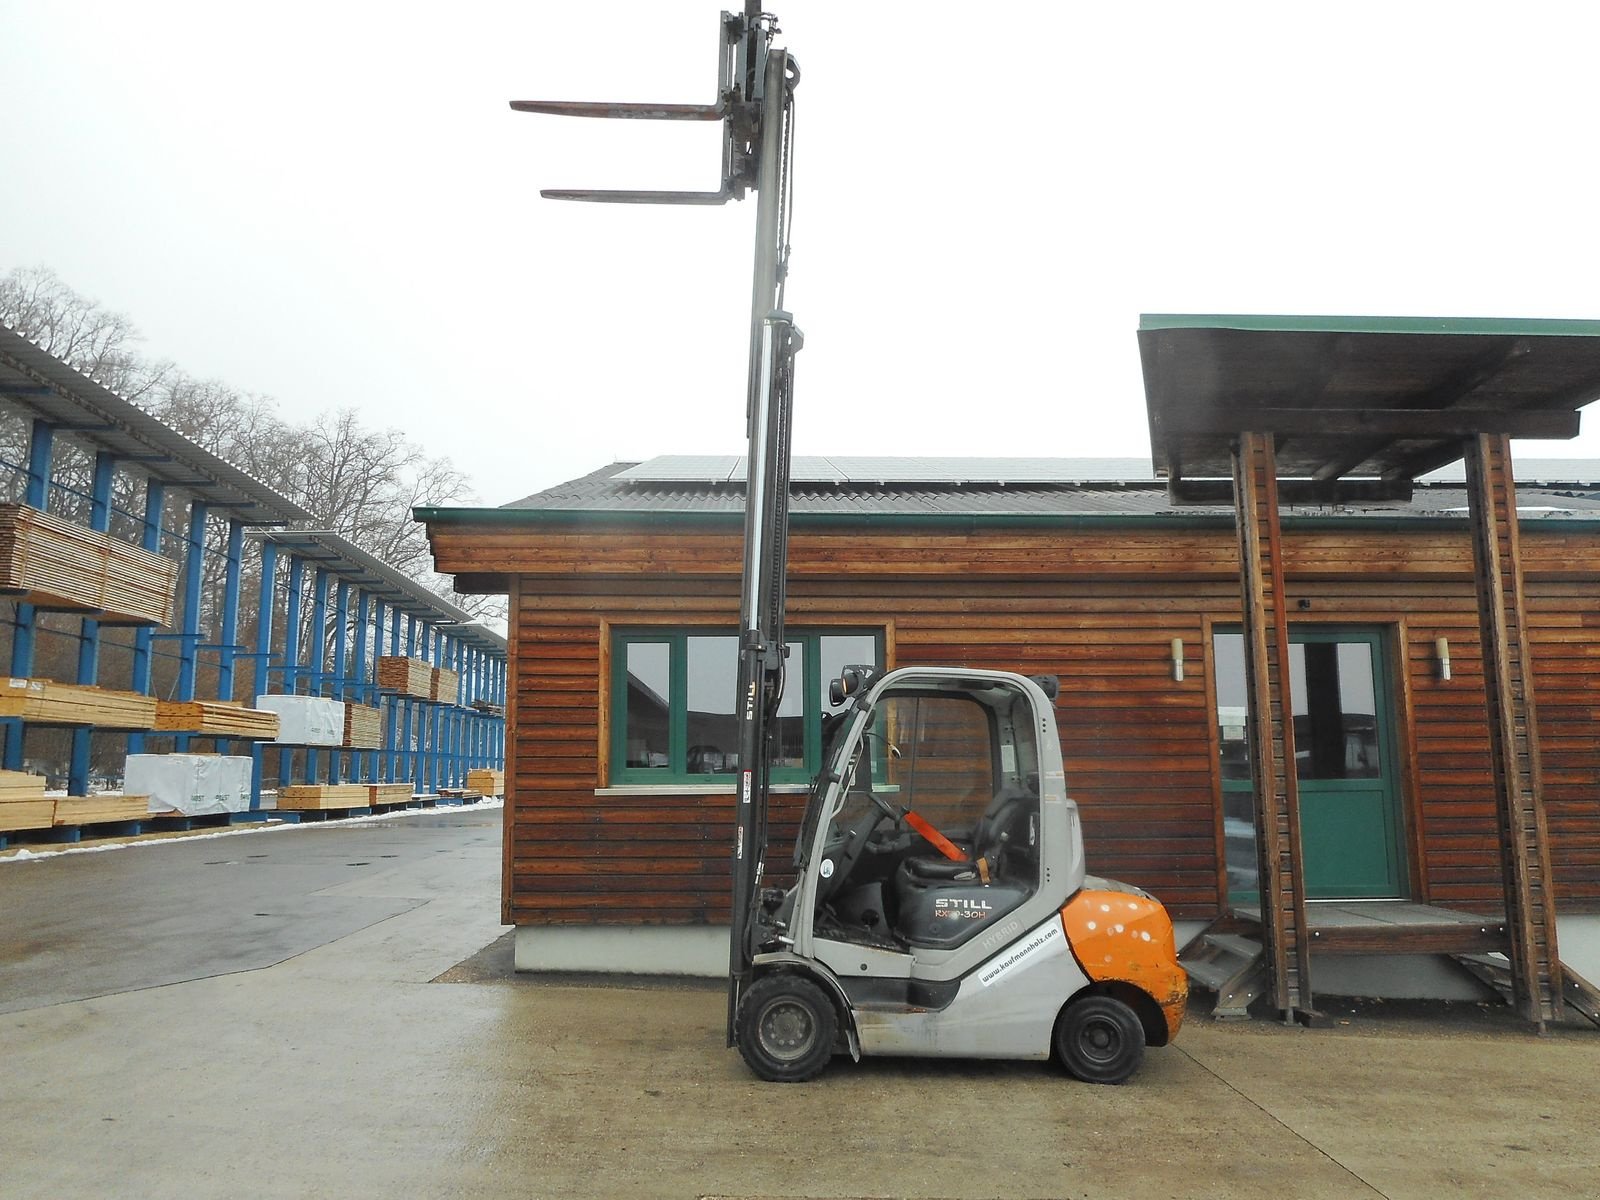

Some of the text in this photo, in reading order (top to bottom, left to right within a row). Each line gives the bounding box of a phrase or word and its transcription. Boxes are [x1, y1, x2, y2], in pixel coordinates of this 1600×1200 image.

[746, 681, 756, 720] STILL
[935, 898, 993, 910] STILL
[935, 909, 987, 919] RX-30H
[982, 921, 1019, 950] HYBRID
[982, 928, 1058, 983] www.kaufmannholz.com
